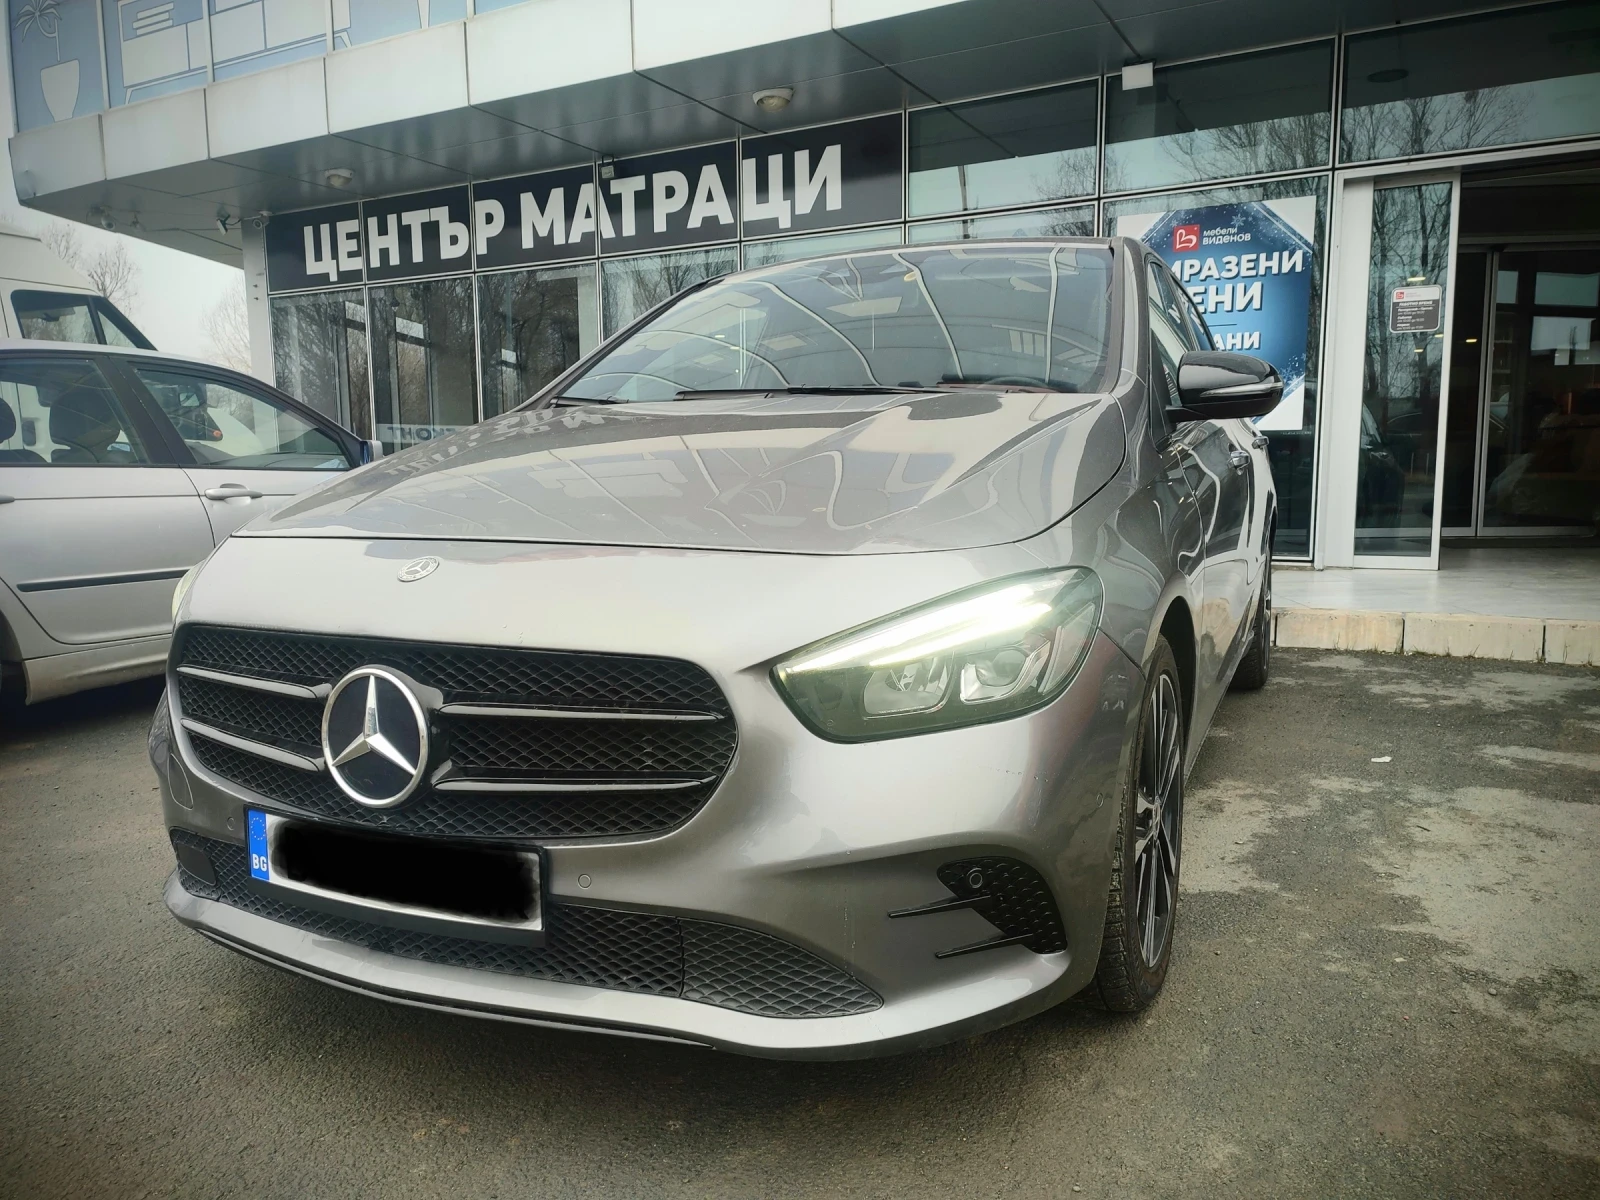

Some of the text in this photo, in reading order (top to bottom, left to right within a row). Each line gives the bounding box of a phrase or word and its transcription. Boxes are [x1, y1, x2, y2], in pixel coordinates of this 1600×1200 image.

[303, 144, 843, 282] ЦЕНТЪР МАТРАЦИ
[1202, 233, 1251, 246] виденов
[1203, 227, 1238, 237] мебели
[1170, 249, 1304, 283] РАЗЕНИ
[1186, 281, 1263, 313] ЕНИ
[1213, 331, 1261, 351] АНИ
[252, 853, 268, 872] BG
